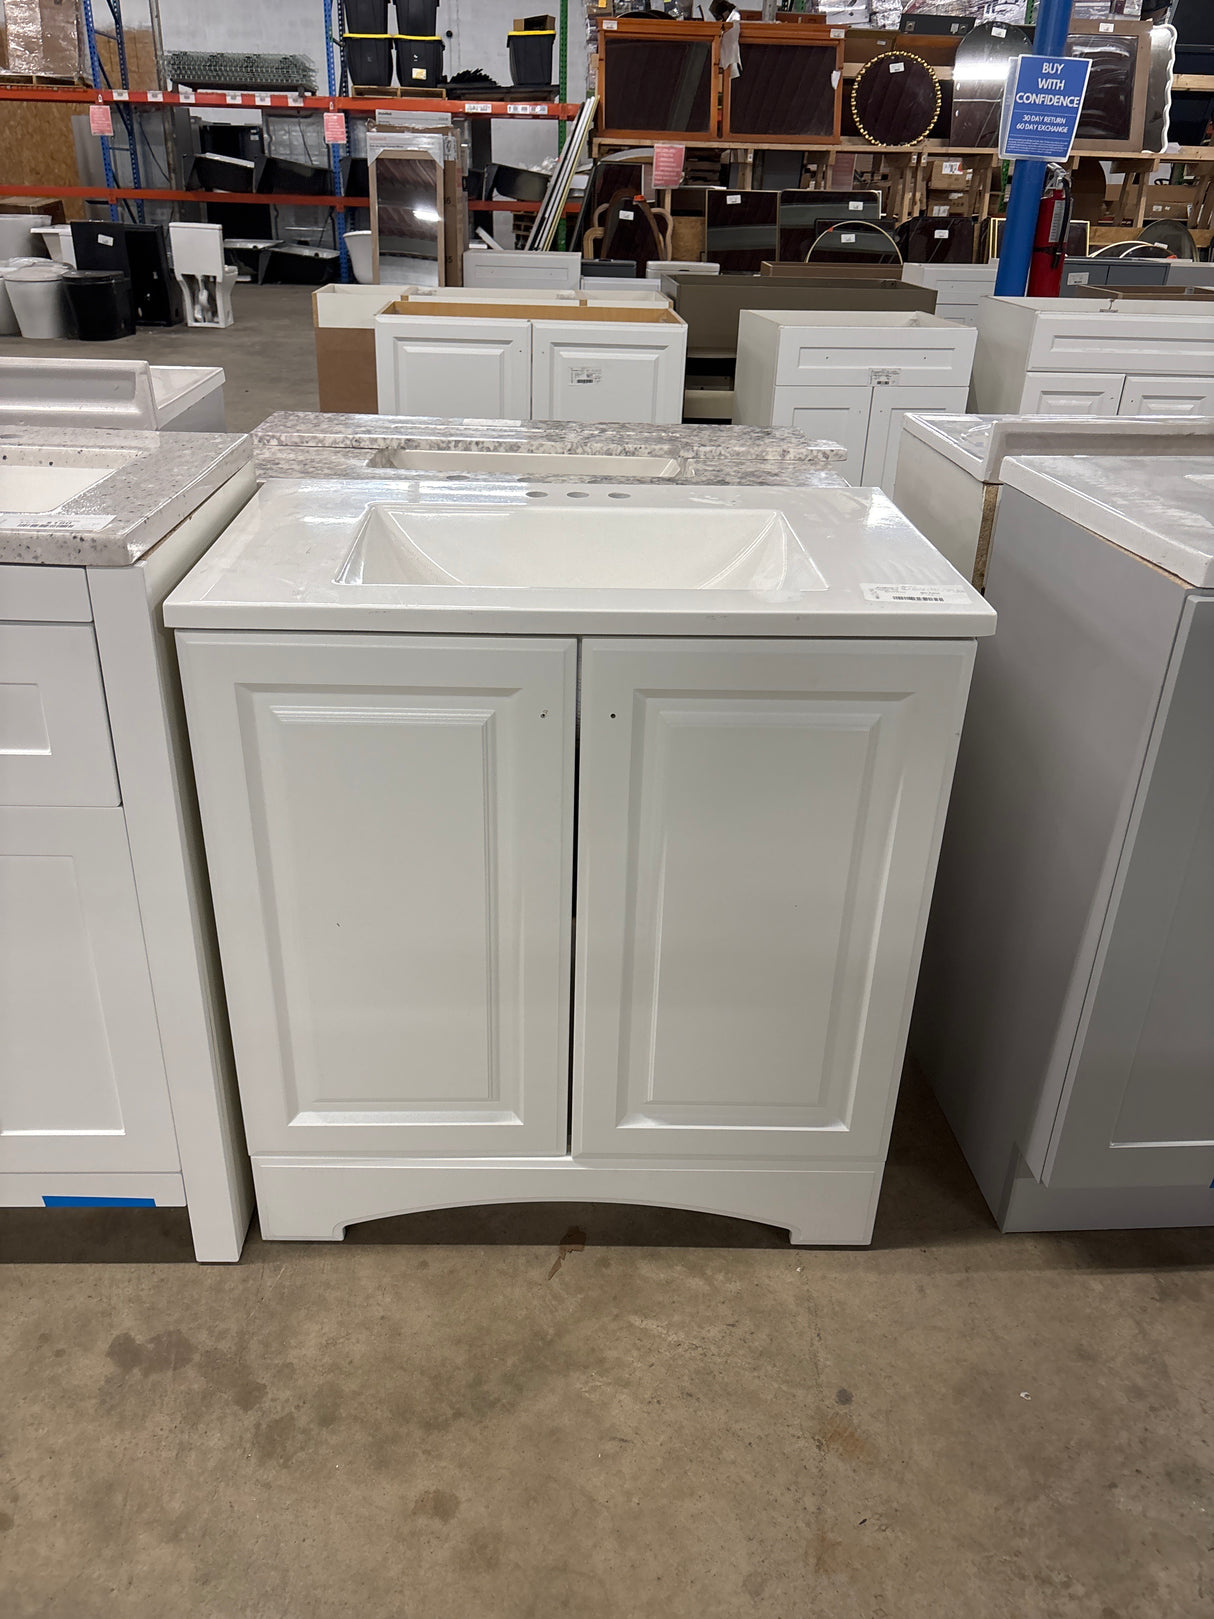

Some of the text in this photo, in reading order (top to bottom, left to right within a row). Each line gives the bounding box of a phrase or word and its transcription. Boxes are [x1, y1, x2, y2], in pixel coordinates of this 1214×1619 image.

[1042, 62, 1064, 75] BUY
[1038, 78, 1065, 90] WITH
[1016, 92, 1080, 107] CONFIDENCE
[1043, 116, 1066, 124] RETURN
[1037, 125, 1068, 133] EXCHANGE
